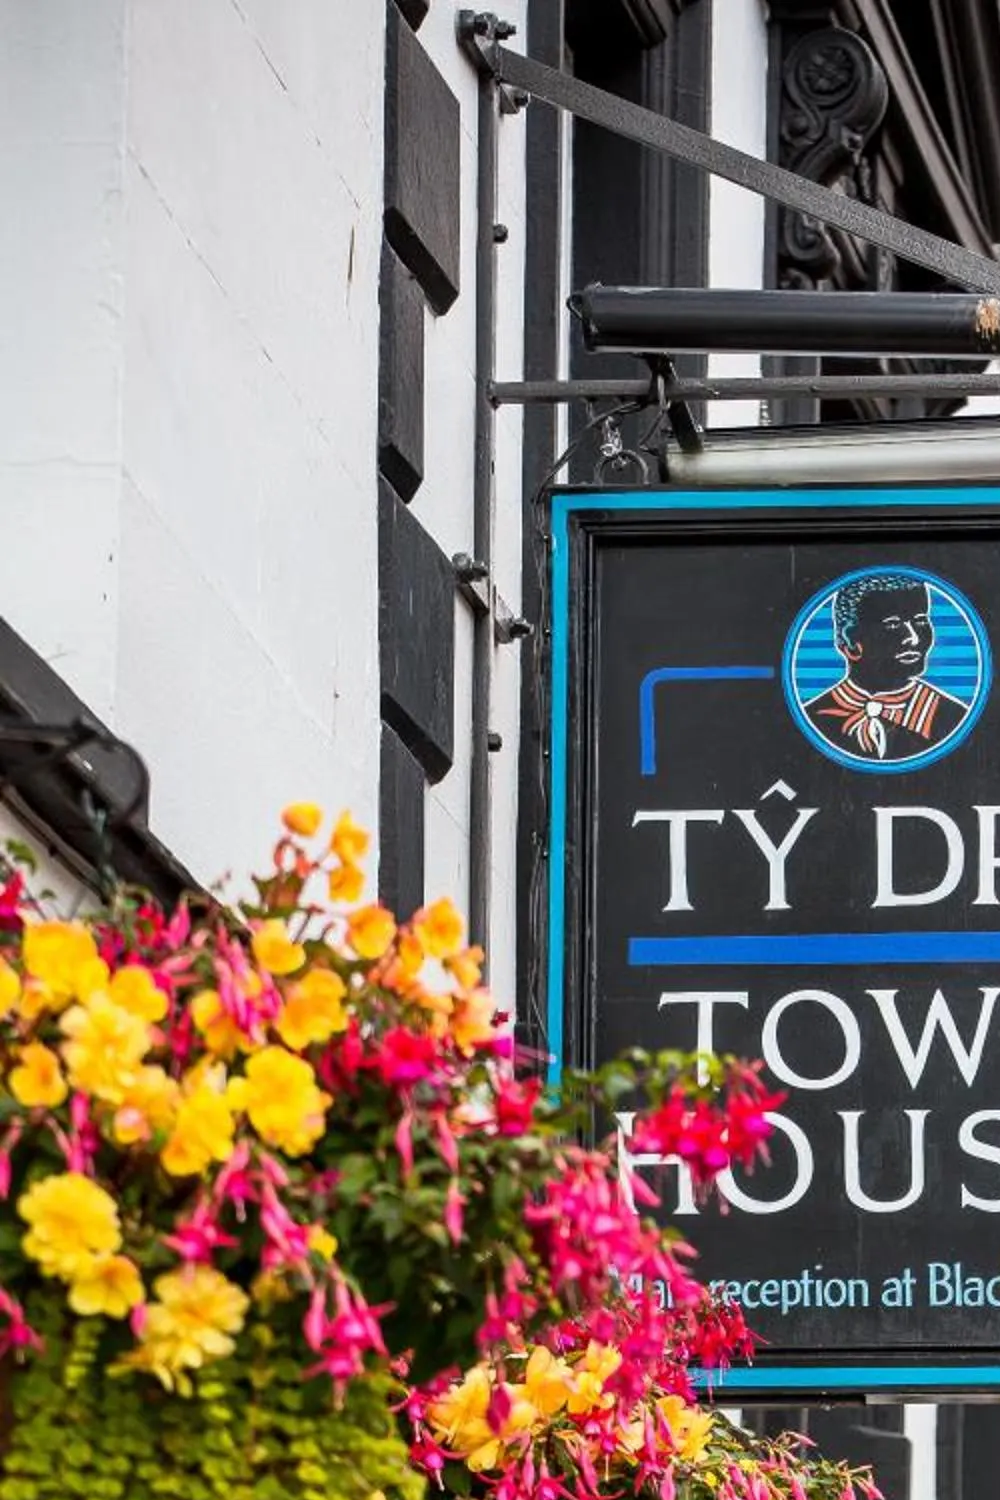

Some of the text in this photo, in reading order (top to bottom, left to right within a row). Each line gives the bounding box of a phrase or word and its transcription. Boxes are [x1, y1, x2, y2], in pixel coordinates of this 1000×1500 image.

[631, 778, 819, 912] TŶ
[709, 1263, 870, 1315] reception
[881, 1267, 917, 1307] at
